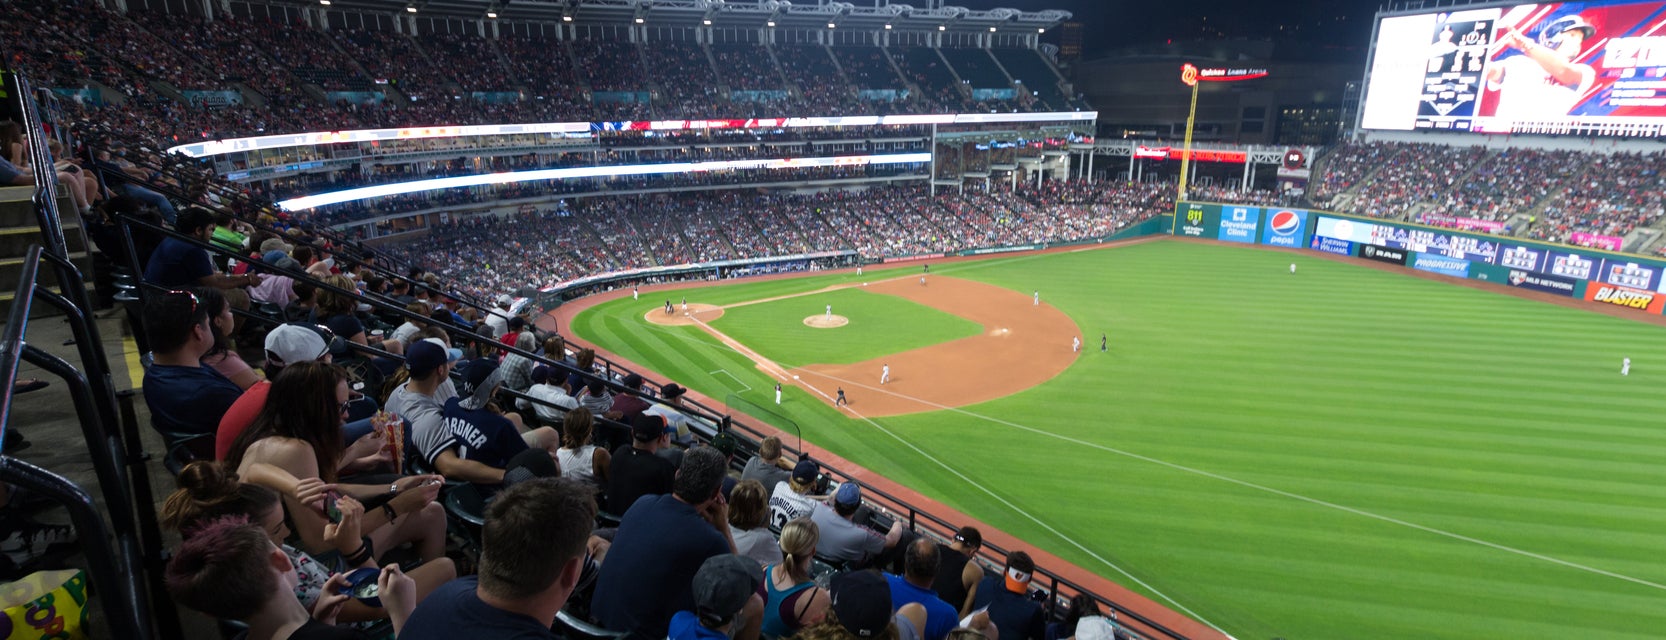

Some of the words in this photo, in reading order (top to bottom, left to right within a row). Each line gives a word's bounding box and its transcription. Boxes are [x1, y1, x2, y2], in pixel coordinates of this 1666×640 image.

[1187, 209, 1203, 222] 811
[1220, 220, 1257, 230] Cleveland
[1226, 228, 1248, 237] Clinic
[1270, 236, 1295, 245] pepsi
[1376, 249, 1402, 260] RAM
[1414, 259, 1468, 271] PROGRESSIVE
[1526, 276, 1540, 285] MLB
[1540, 279, 1574, 291] NETWORK
[1594, 286, 1653, 310] BLASTER
[444, 417, 488, 450] ARDNER
